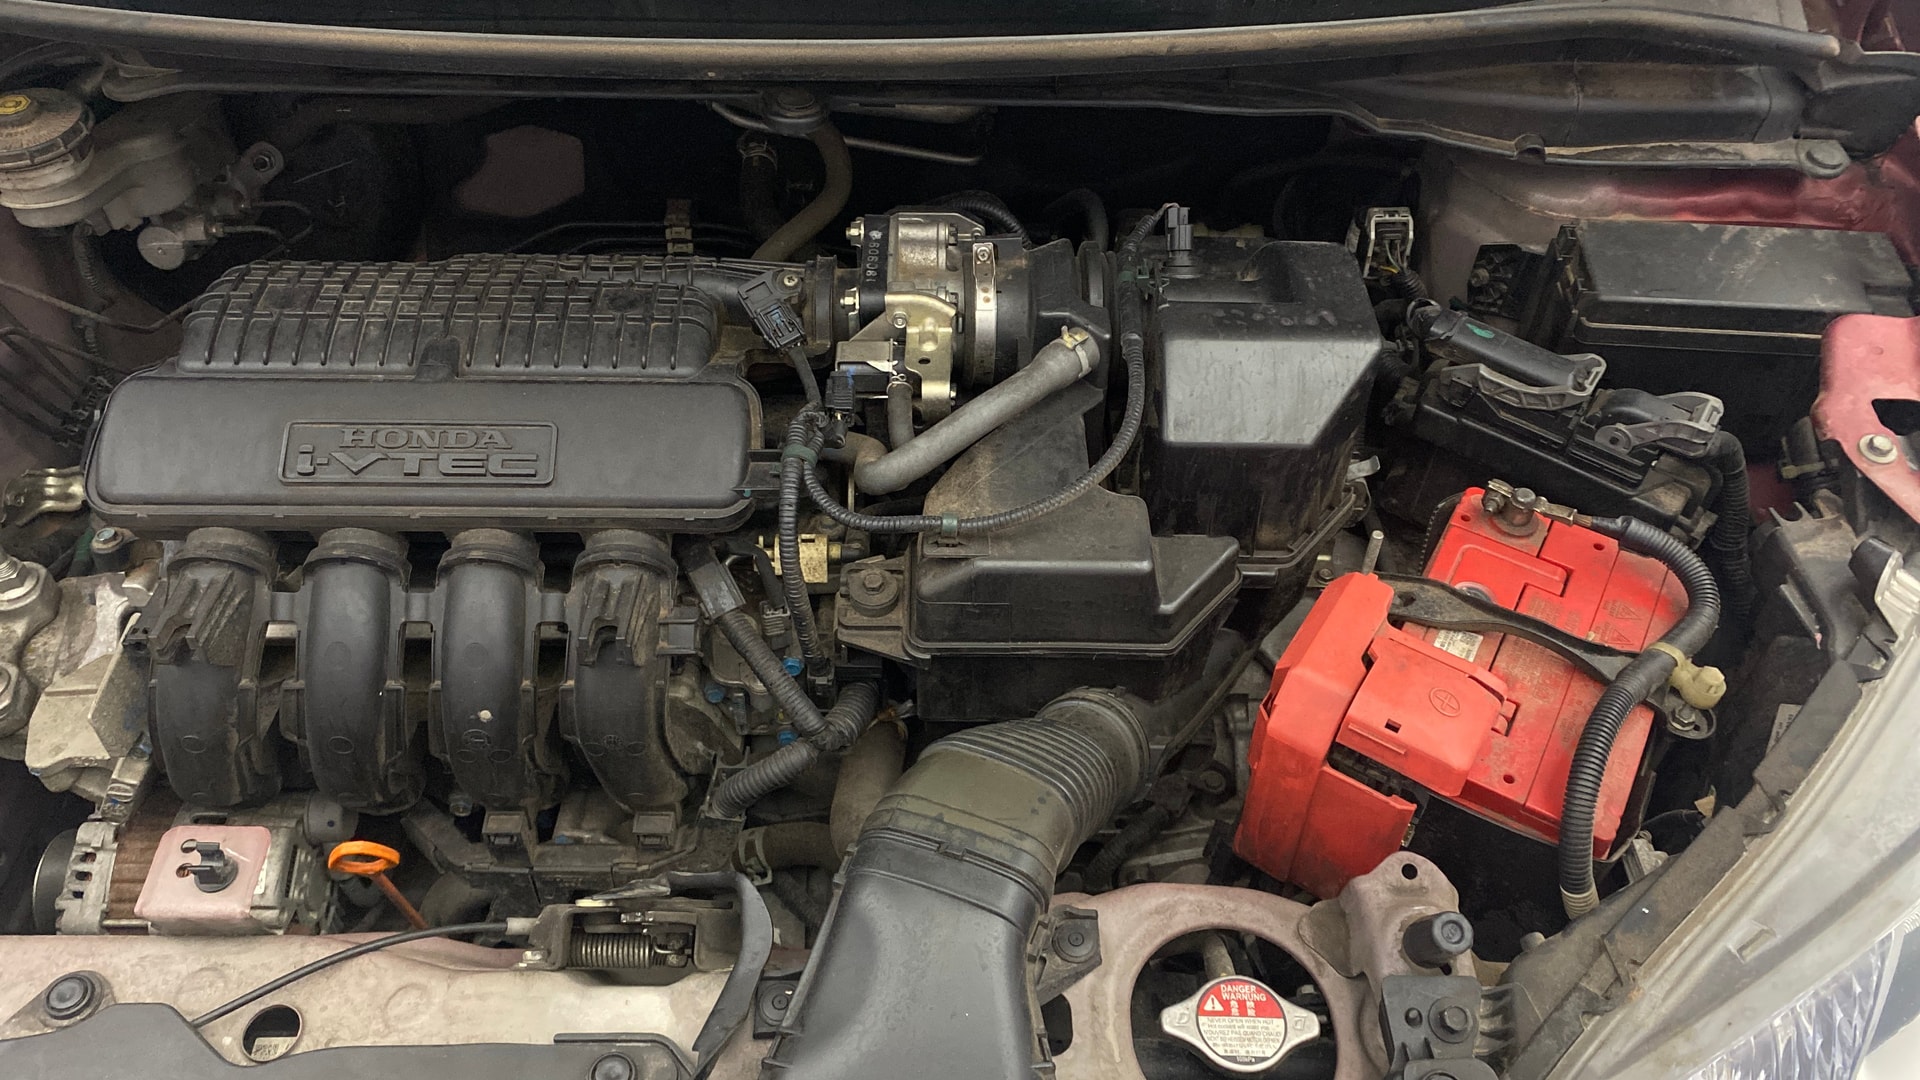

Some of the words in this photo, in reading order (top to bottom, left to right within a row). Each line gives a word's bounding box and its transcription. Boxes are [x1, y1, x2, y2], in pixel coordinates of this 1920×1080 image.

[339, 428, 512, 450] HONDA
[297, 444, 538, 478] i-VTEC
[1220, 984, 1257, 994] DANGER
[1221, 992, 1267, 1002] WARNUNG
